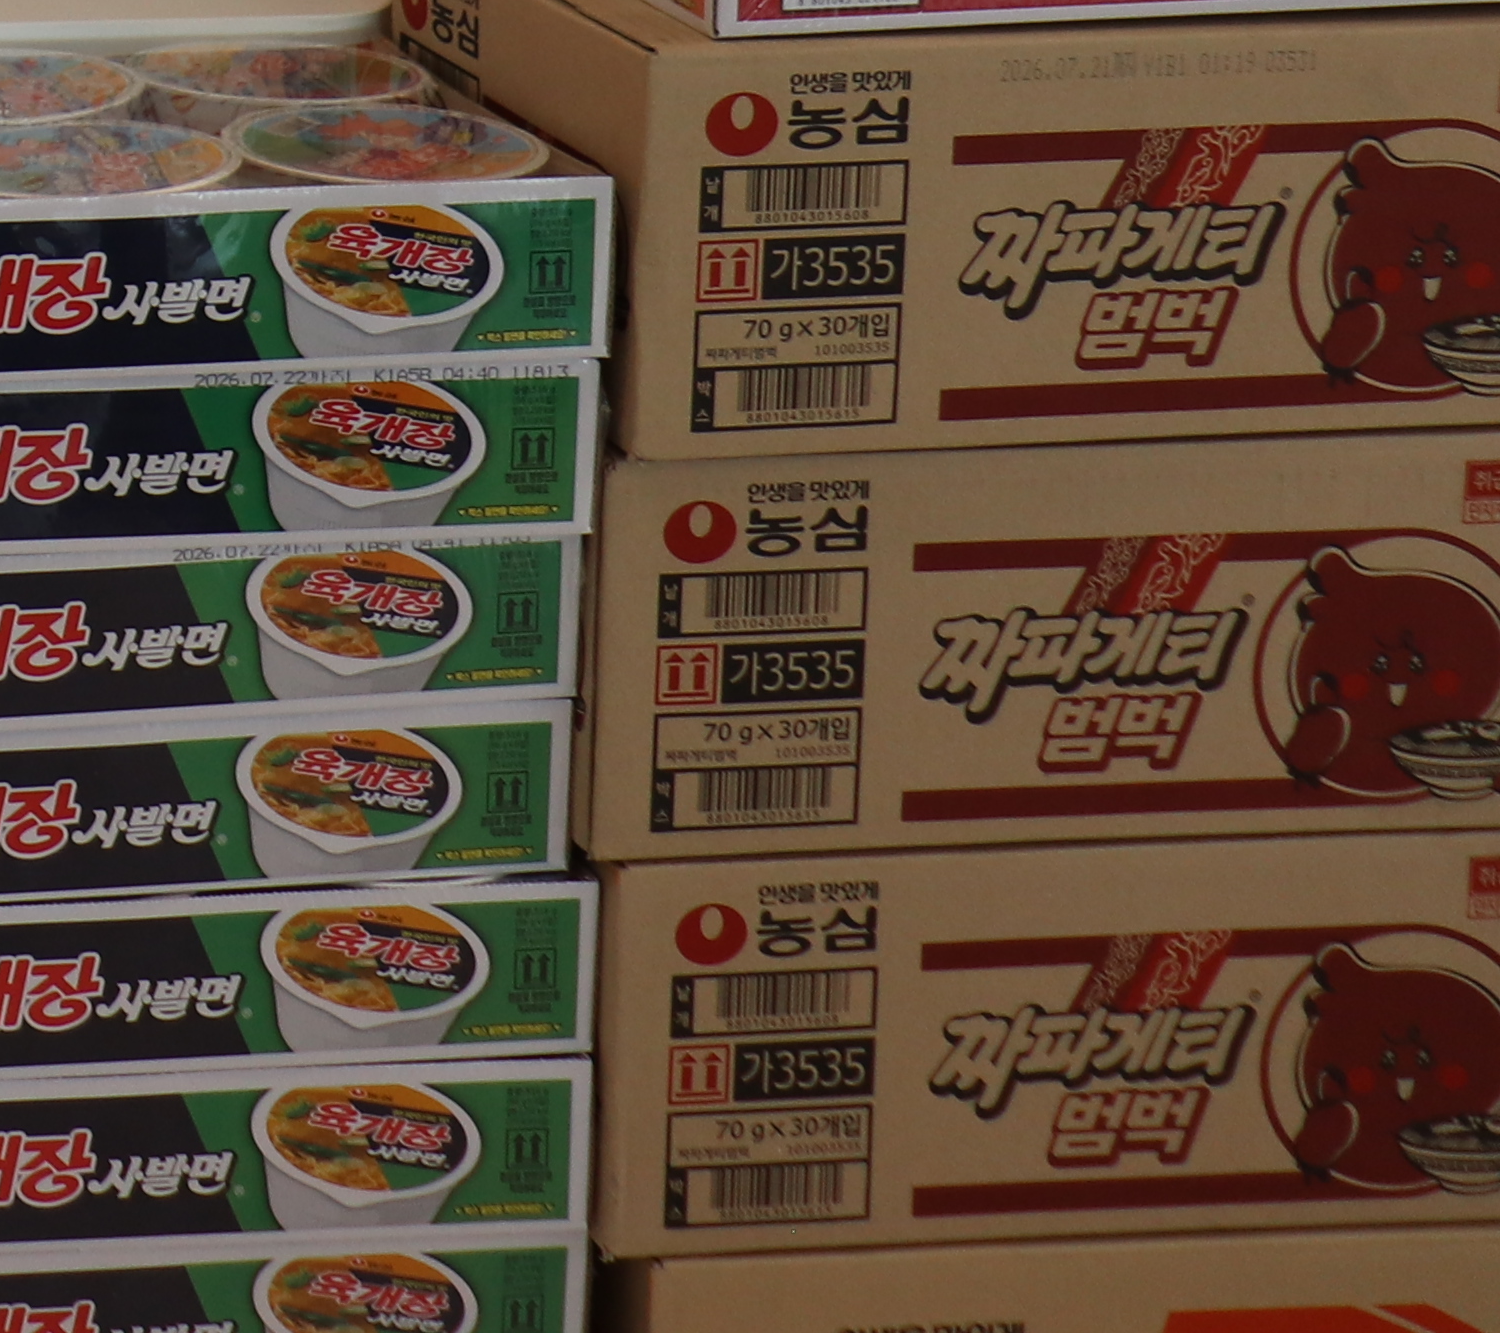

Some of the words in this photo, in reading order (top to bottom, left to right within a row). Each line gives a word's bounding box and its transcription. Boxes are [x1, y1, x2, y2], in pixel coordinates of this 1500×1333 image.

[789, 72, 847, 94] 인생을
[852, 70, 911, 92] 맛있게
[787, 96, 910, 150] 농심
[770, 244, 896, 290] 가3535
[958, 199, 1287, 320] 짜파게티
[101, 277, 251, 324] 사발면
[1074, 285, 1240, 371] 범벅
[747, 482, 806, 503] 인생을
[810, 480, 870, 501] 맛있게
[746, 505, 869, 558] 농심
[81, 622, 227, 670] 사발면
[919, 605, 1247, 724] 짜파게티
[730, 650, 856, 696] 가3535
[1036, 690, 1202, 773] 범벅
[756, 905, 879, 959] 농심
[94, 975, 241, 1022] 사발면
[741, 1047, 868, 1094] 가3535
[928, 1002, 1257, 1121] 짜파게티
[1047, 1085, 1211, 1170] 범벅
